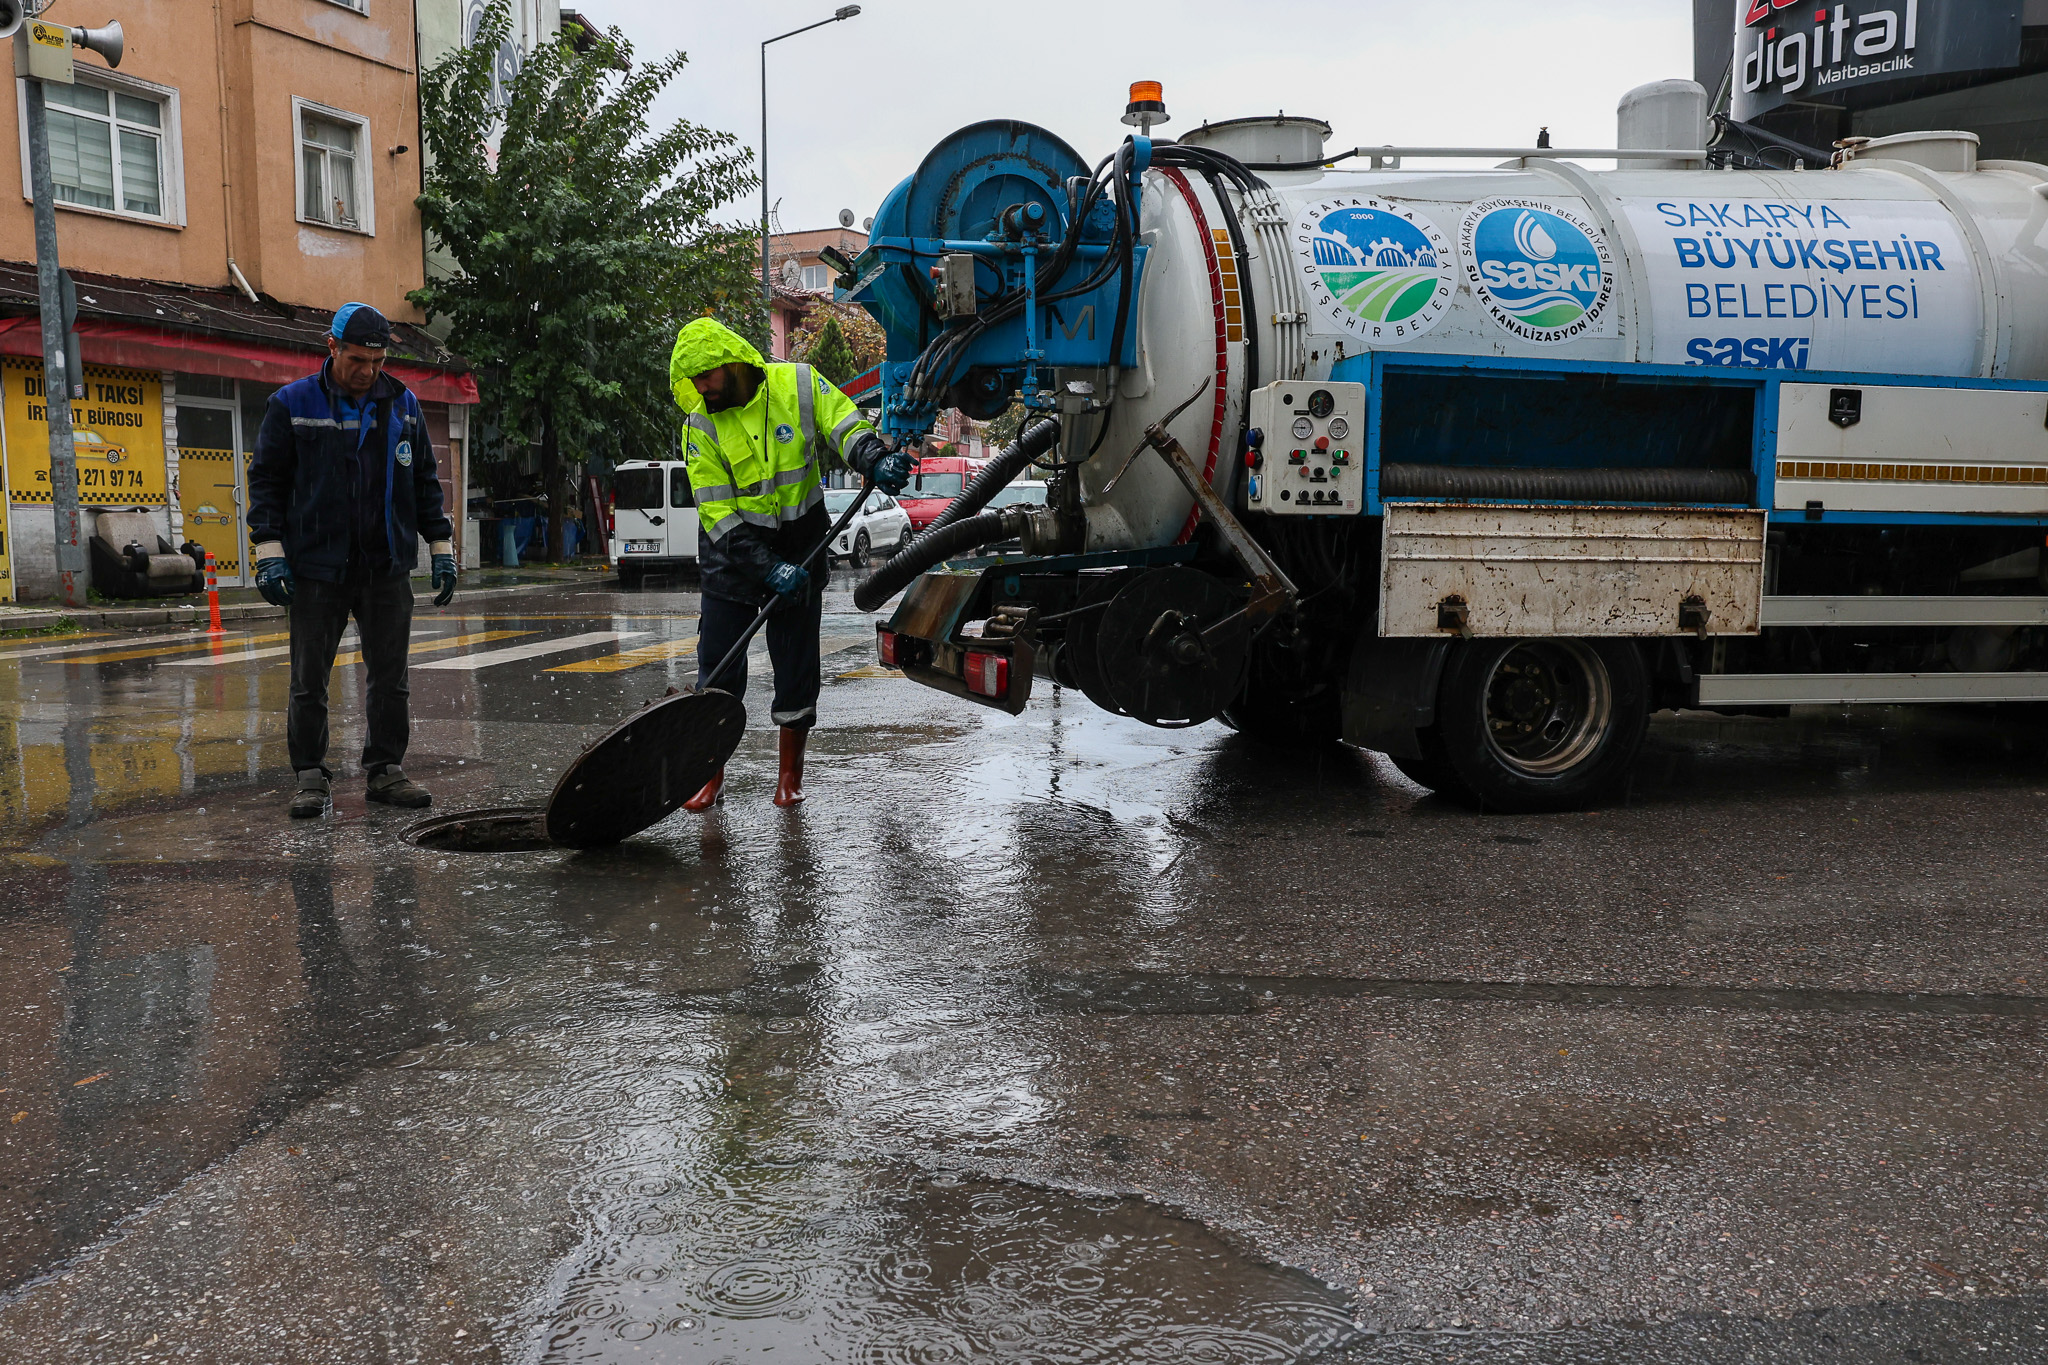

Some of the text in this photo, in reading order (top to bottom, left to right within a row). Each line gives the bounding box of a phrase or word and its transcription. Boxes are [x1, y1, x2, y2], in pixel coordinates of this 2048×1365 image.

[1742, 0, 1917, 94] digital
[1817, 54, 1914, 86] Matbaacılık
[1309, 198, 1414, 221] SAKARYA
[1656, 202, 1851, 229] SAKARYA
[1462, 198, 1613, 264] SAKARYA BÜYÜKŞEHİR BELEDİYESİ
[1673, 231, 1945, 274] BÜYÜKŞEHİR
[1298, 222, 1382, 337] BÜYÜKŞEHİR
[1685, 277, 1918, 319] BELEDİYESİ
[1466, 265, 1480, 283] SU
[1477, 286, 1492, 306] VE
[1490, 306, 1587, 342] KANALİZASYON
[1585, 271, 1613, 322] İDARESİ
[95, 383, 144, 406] TAKSİ
[87, 407, 143, 428] BÜROSU
[84, 468, 105, 486] 271
[110, 469, 124, 487] 97
[128, 470, 143, 487] 74
